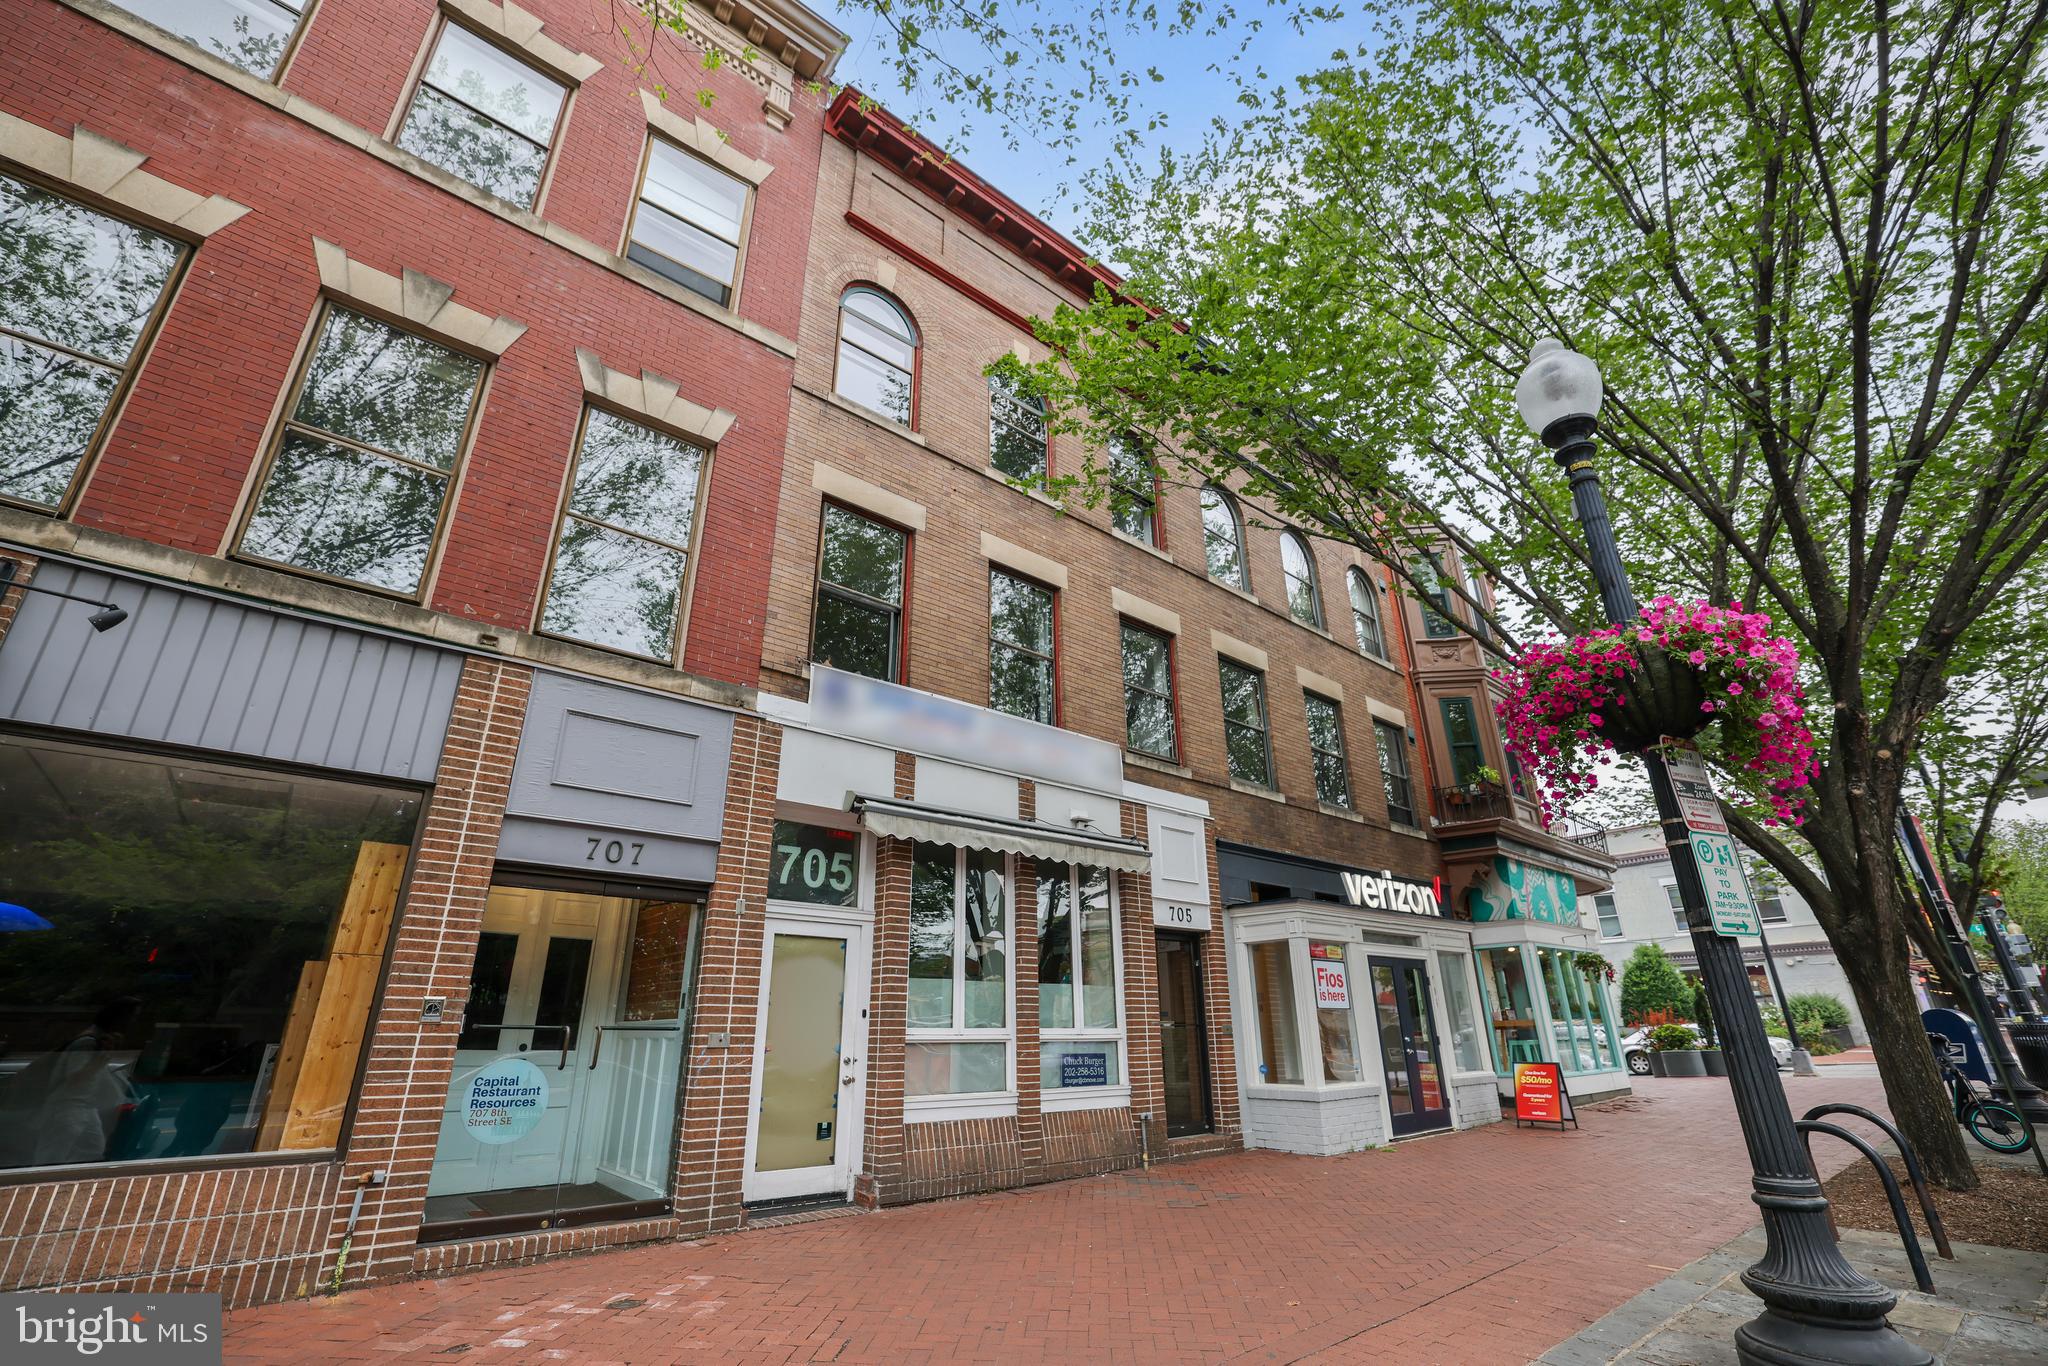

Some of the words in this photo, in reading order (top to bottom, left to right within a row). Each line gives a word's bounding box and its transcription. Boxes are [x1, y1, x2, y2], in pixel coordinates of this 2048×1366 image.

[587, 837, 644, 865] 707
[777, 845, 853, 892] 705
[1714, 867, 1728, 877] PAY
[1719, 880, 1731, 889] TO
[1340, 870, 1440, 917] verizon
[1717, 891, 1739, 901] PARK
[1169, 906, 1192, 923] 705
[1317, 967, 1344, 989] Fios
[1319, 988, 1327, 1001] is
[1327, 988, 1345, 1002] here
[1063, 1056, 1083, 1065] Chuck
[1084, 1056, 1104, 1066] Burger
[1064, 1066, 1105, 1077] 202-258-5316
[474, 1076, 519, 1089] Capital
[1520, 1075, 1553, 1085] $50/mo
[472, 1086, 541, 1098] Restaurant
[470, 1098, 536, 1109] Resources
[470, 1109, 489, 1118] 707
[491, 1108, 507, 1117] 8th
[468, 1118, 497, 1127] Street
[500, 1117, 512, 1125] SE
